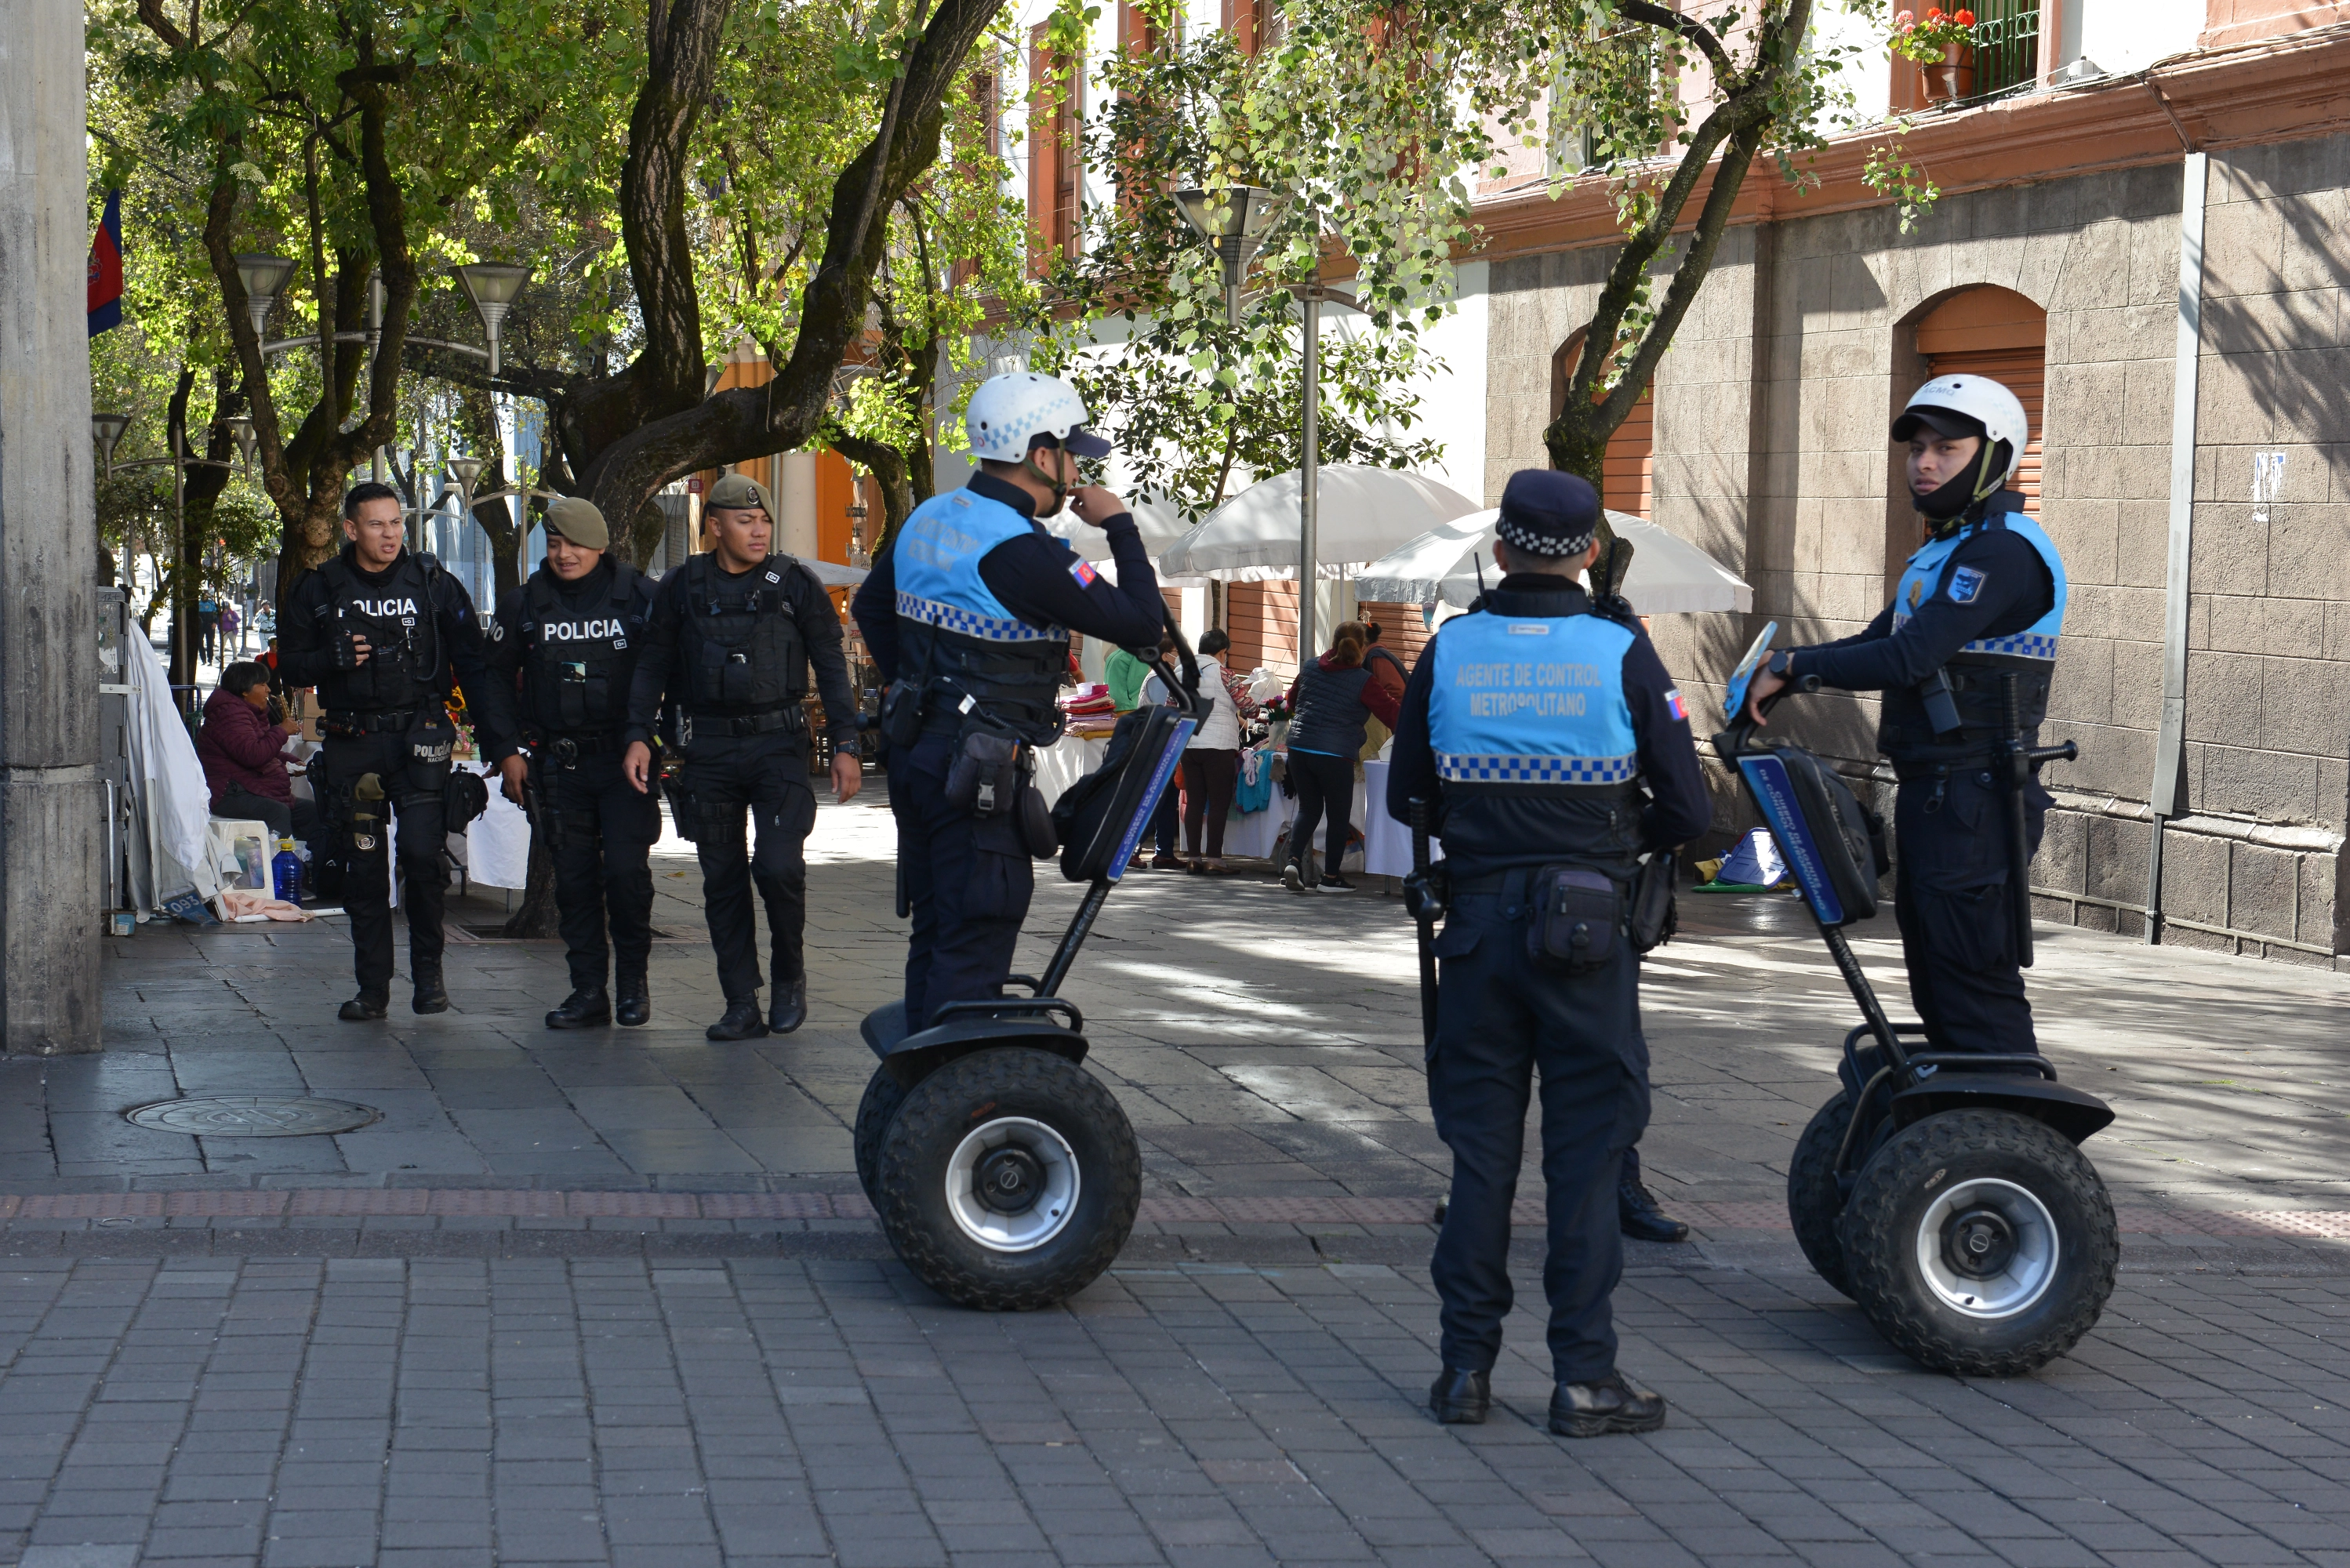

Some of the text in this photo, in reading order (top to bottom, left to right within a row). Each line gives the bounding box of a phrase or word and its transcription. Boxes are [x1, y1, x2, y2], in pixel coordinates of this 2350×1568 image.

[544, 619, 625, 641] POLICIA
[1456, 663, 1603, 687] AGENTE DE CONTROL
[1758, 768, 1769, 782] DE
[1764, 782, 1789, 829] CONTROL
[170, 895, 199, 913] 093
